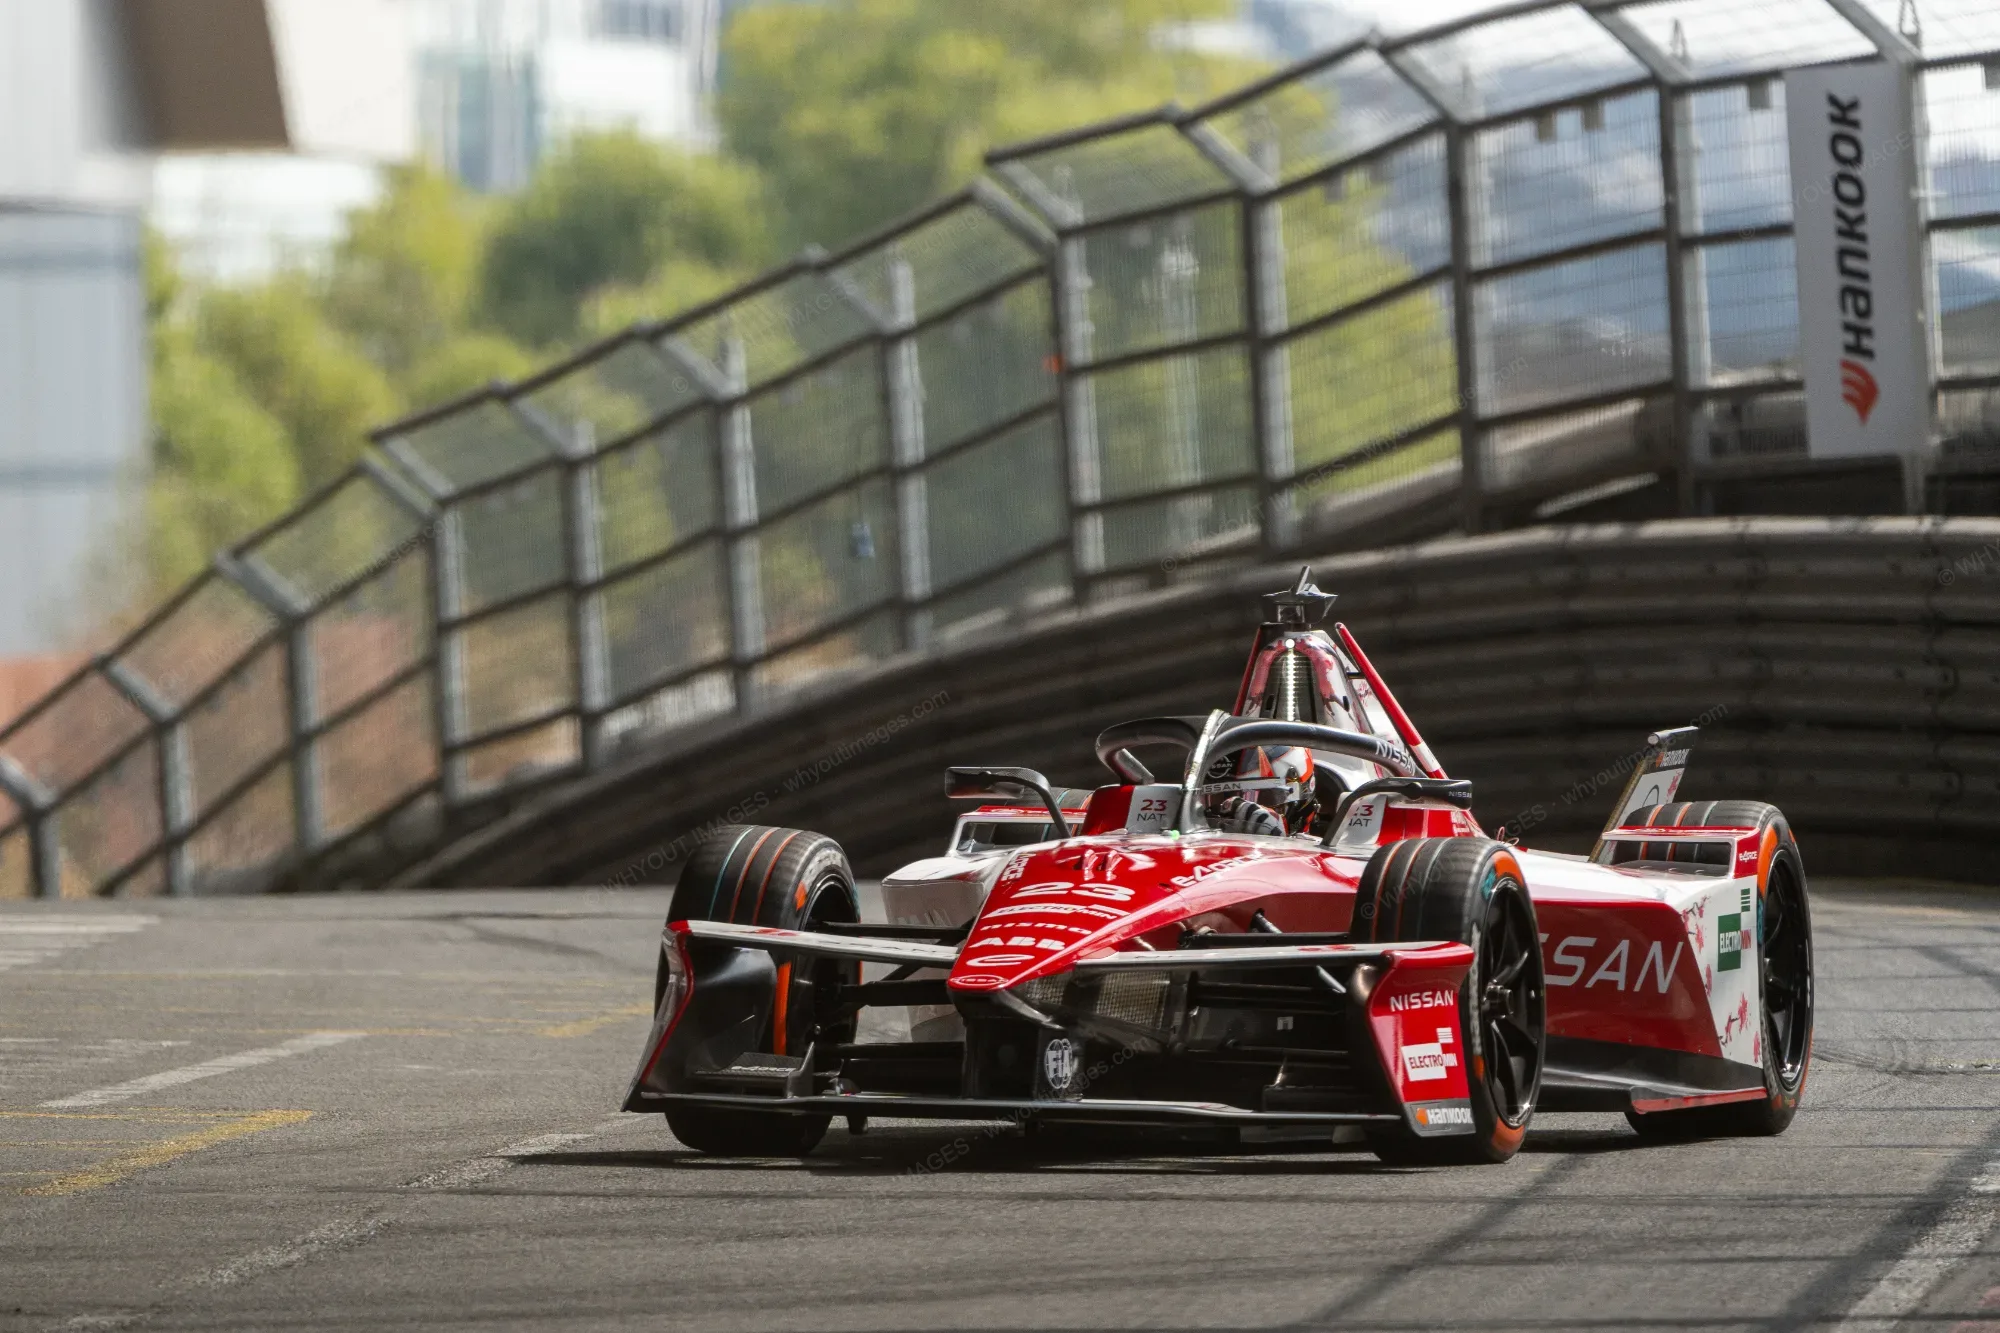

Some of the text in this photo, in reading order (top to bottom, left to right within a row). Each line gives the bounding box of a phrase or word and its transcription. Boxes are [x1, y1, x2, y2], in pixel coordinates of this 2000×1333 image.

[1201, 783, 1241, 794] ISSAN
[1140, 799, 1167, 812] 23
[1136, 813, 1167, 821] NAT
[1010, 881, 1136, 902] 23
[969, 936, 1066, 951] ABB
[1390, 990, 1454, 1012] NISSAN
[1408, 1053, 1458, 1070] ELECTROMIN
